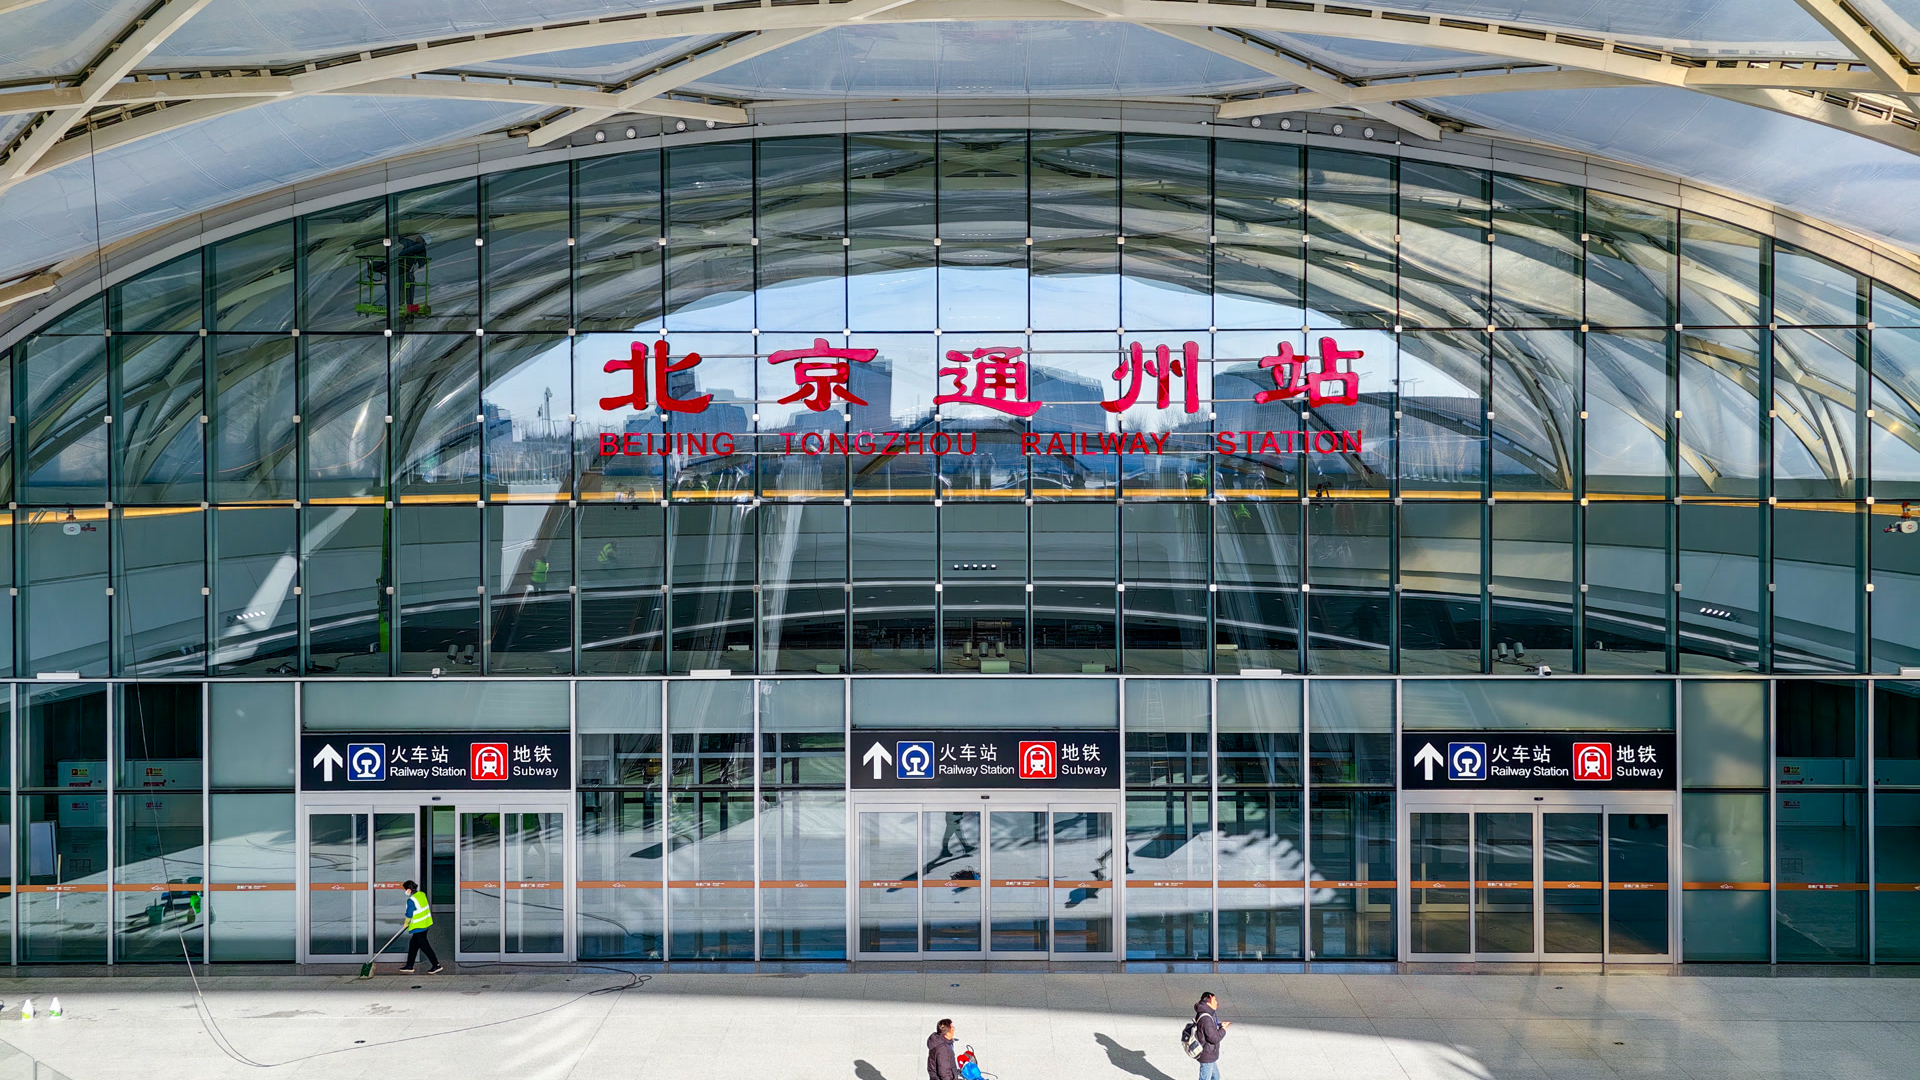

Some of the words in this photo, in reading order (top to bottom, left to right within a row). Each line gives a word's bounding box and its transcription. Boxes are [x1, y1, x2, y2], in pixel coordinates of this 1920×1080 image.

[599, 338, 1364, 417] 北京通州站
[600, 433, 734, 456] BEIJING
[780, 432, 976, 455] TONGZHOU
[1022, 432, 1170, 455] RAILWAY
[1218, 430, 1362, 454] STATION
[391, 746, 448, 763] 火车站
[513, 745, 551, 762] 地铁
[940, 744, 997, 761] 火车站
[1062, 743, 1100, 761] 地铁
[1492, 745, 1550, 763] 火车站
[1617, 745, 1656, 763] 地铁
[390, 767, 429, 778] Railway
[432, 767, 466, 776] Station
[513, 766, 558, 778] Subway
[939, 765, 978, 776] Railway
[980, 765, 1014, 774] Station
[1062, 765, 1107, 776] Subway
[1491, 766, 1531, 778] Railway
[1534, 766, 1568, 776] Station
[1617, 766, 1663, 778] Subway
